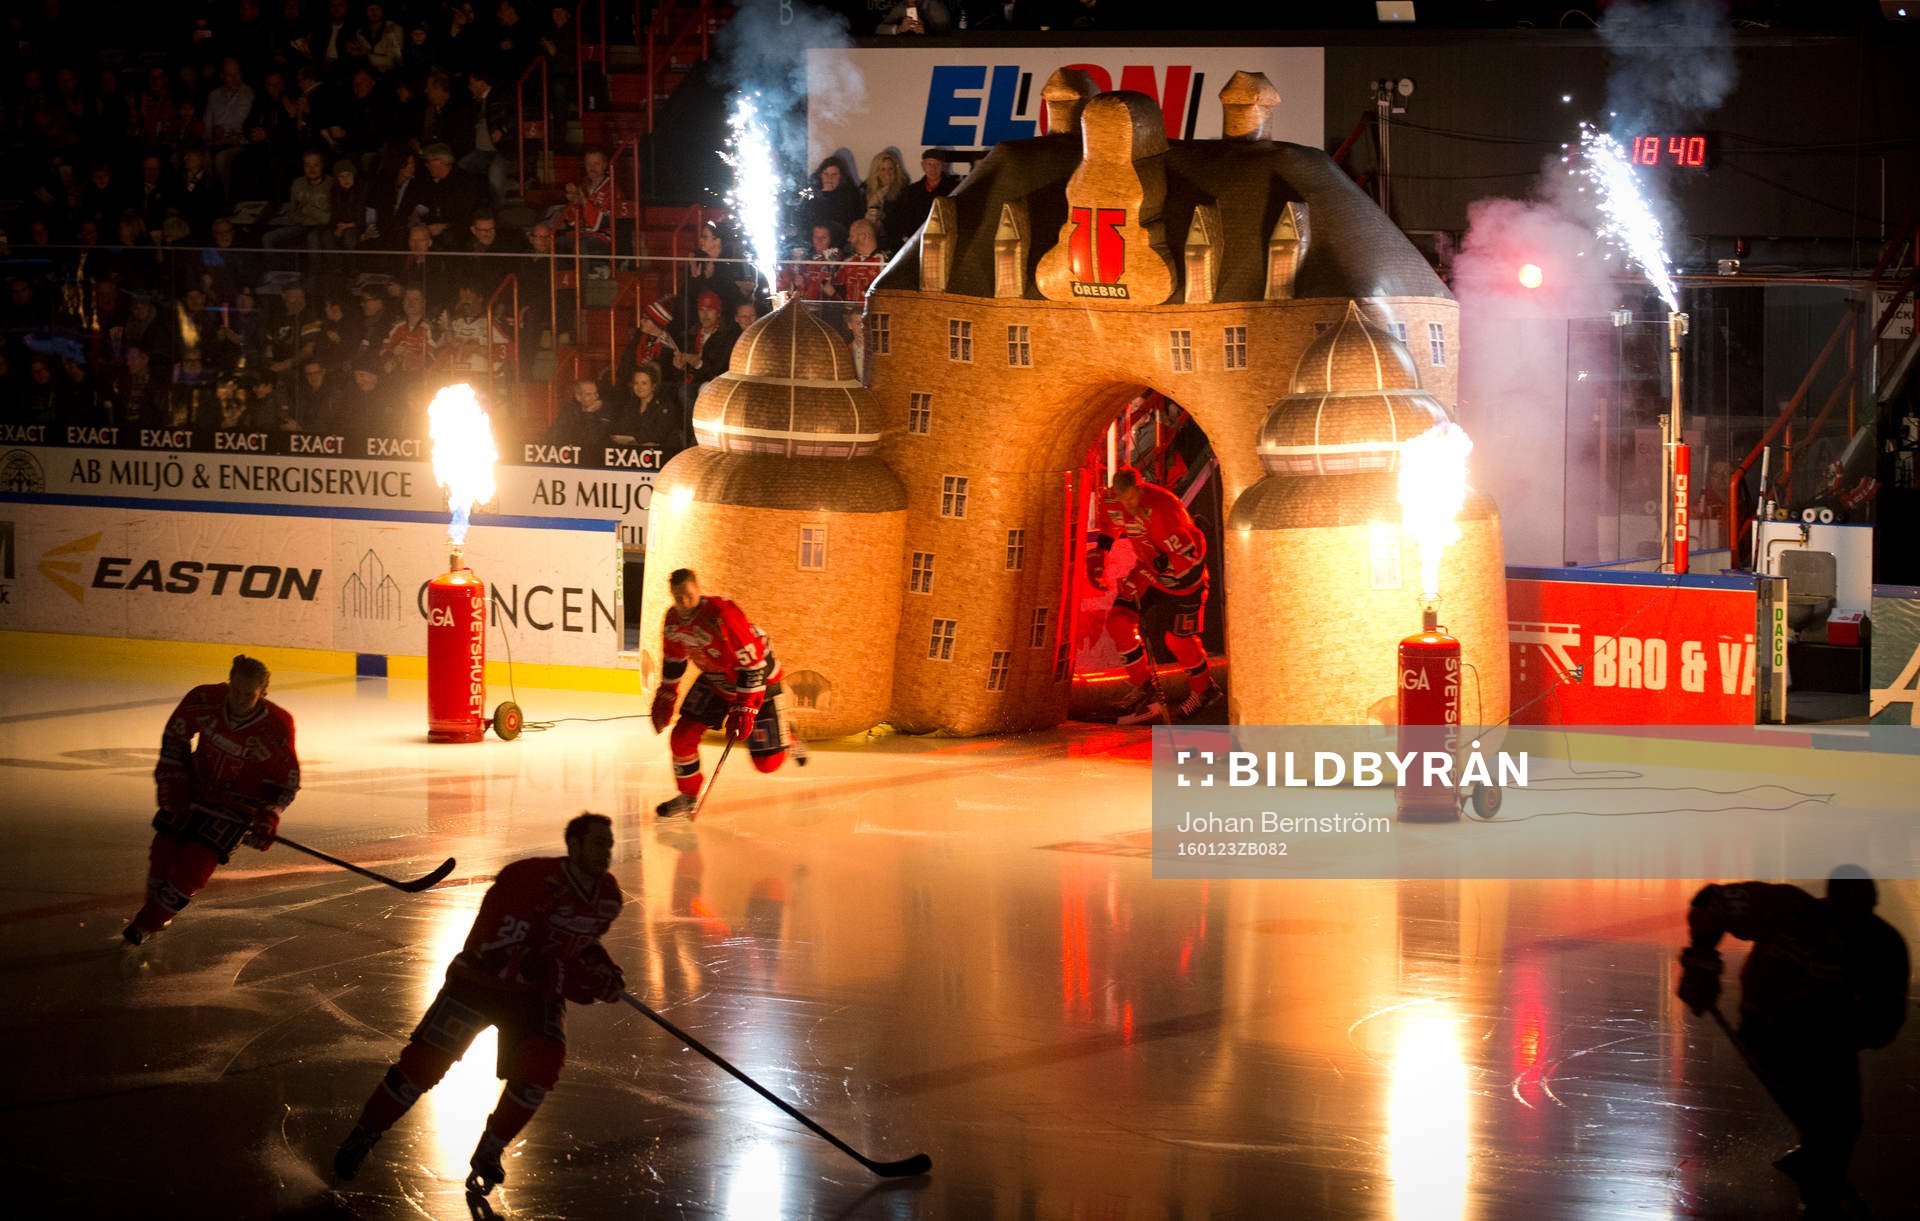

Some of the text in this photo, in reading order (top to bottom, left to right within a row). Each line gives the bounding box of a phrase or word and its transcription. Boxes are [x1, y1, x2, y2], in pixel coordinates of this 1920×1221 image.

[1632, 136, 1706, 167] 18 40
[1073, 282, 1127, 298] ÖREBRO
[67, 426, 119, 445] EXACT
[140, 429, 193, 448] EXACT
[215, 432, 268, 451] EXACT
[290, 435, 344, 454] EXACT
[367, 438, 422, 457] EXACT
[524, 444, 581, 465] EXACT
[605, 448, 663, 468] EXACT
[69, 459, 101, 484] AB
[110, 455, 183, 491] MILJÖ
[192, 464, 210, 489] &
[219, 465, 412, 497] ENERGISERVICE
[532, 476, 653, 515] AB MILJÖ
[1675, 475, 1688, 541] DACO
[1163, 534, 1182, 553] 12
[92, 557, 322, 601] EASTON
[470, 596, 484, 717] SVETSHUSET
[1775, 608, 1783, 666] DACO
[1594, 636, 1667, 690] BRO
[1681, 641, 1707, 692] &
[497, 914, 531, 943] 26
